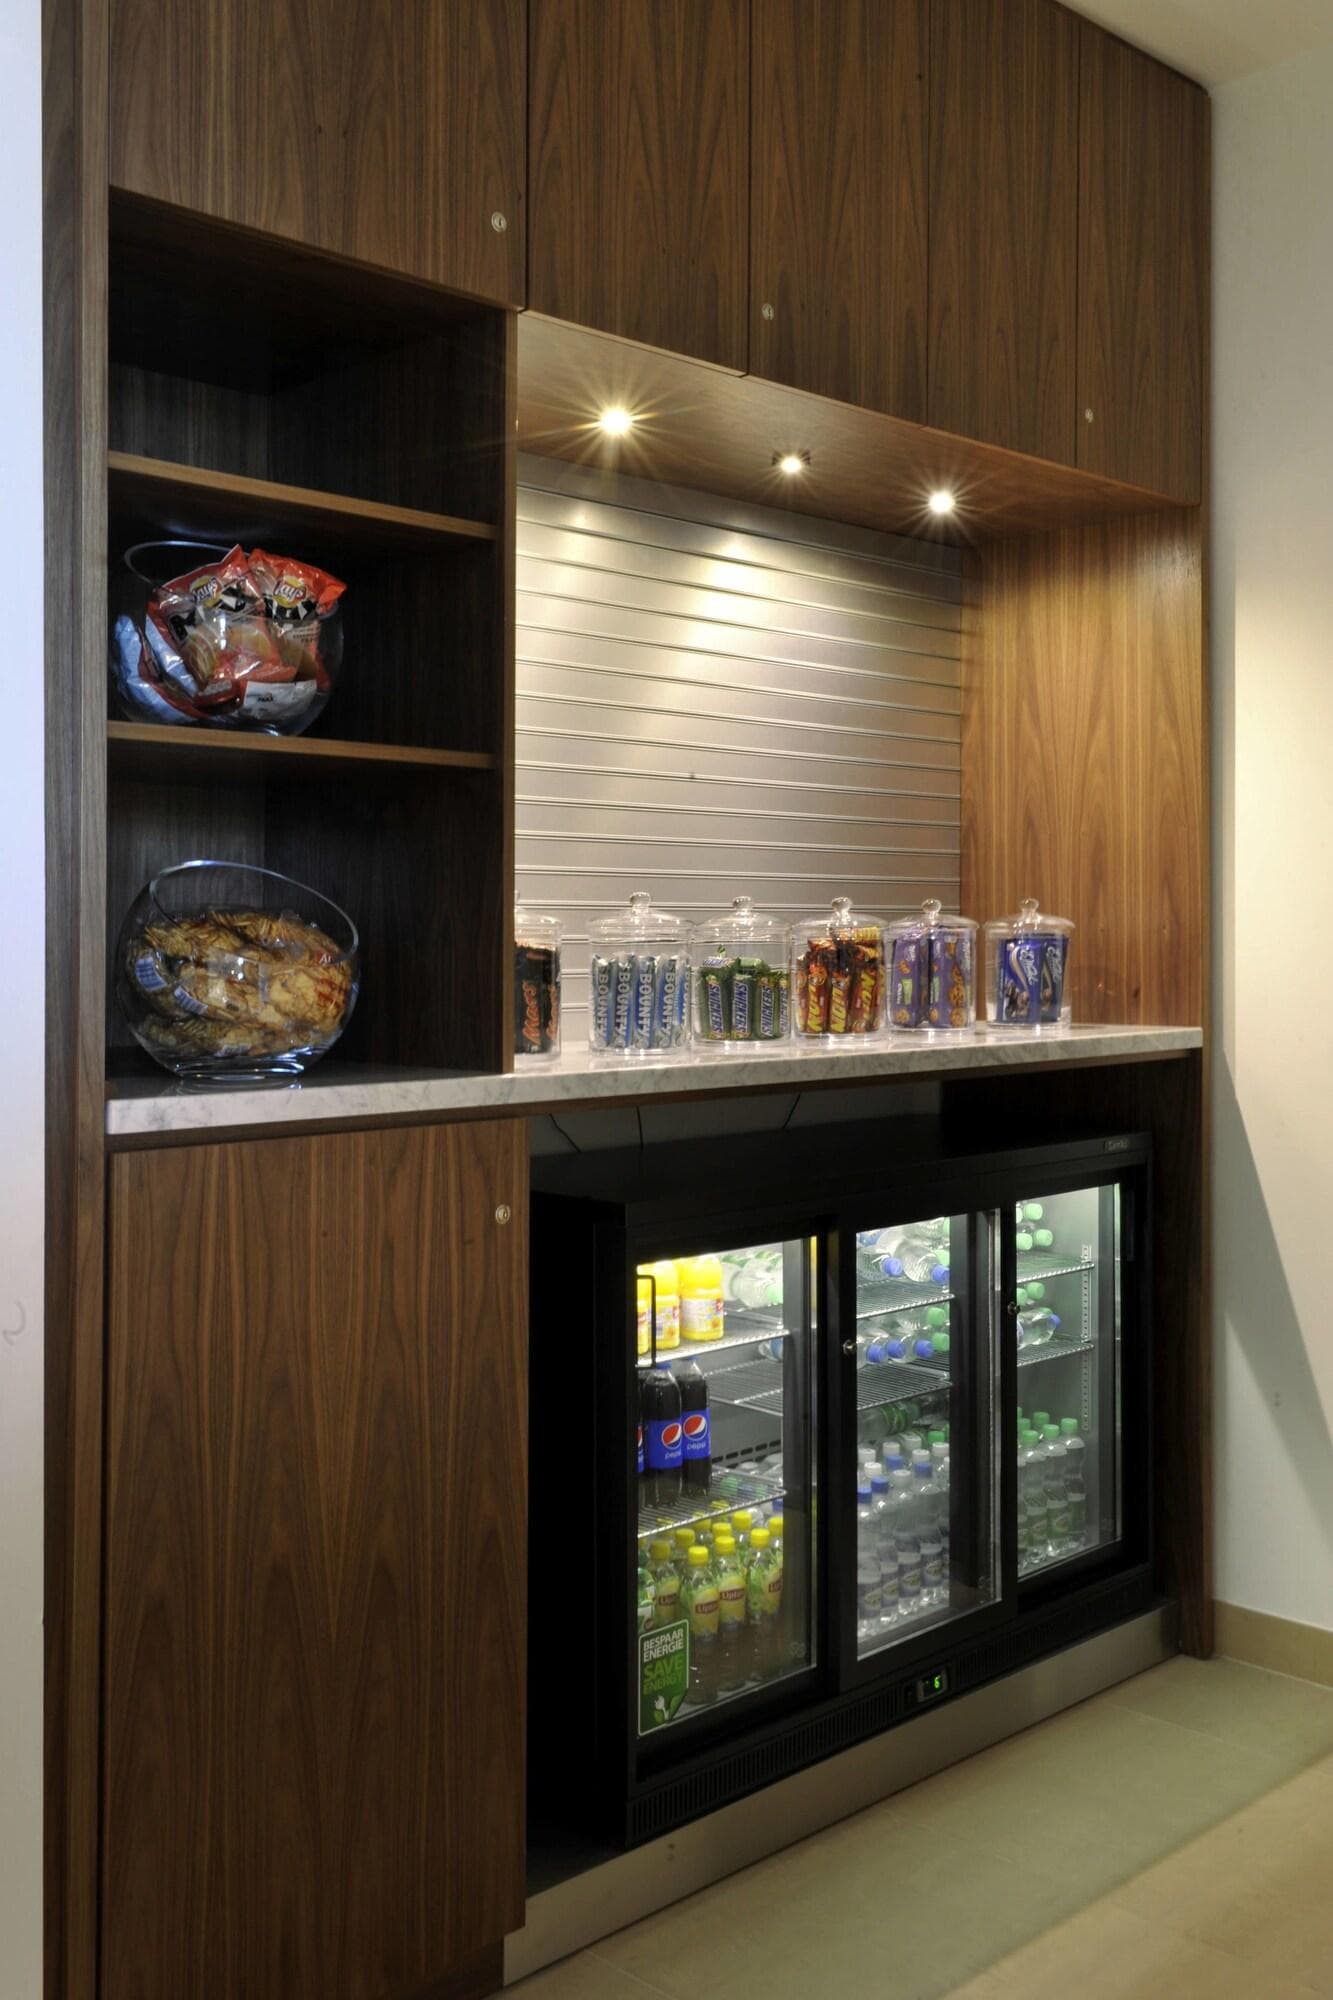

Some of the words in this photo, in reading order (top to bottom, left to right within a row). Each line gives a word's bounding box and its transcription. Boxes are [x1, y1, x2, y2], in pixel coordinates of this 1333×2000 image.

[613, 972, 630, 1036] BOUNTY
[638, 973, 652, 1037] BOUNTY
[662, 972, 675, 1035] BOUNTY
[709, 984, 723, 1033] SNICKERS
[734, 981, 748, 1033] SNICKERS
[761, 985, 774, 1036] SNICKERS
[830, 986, 847, 1032] LION
[644, 1628, 684, 1652] BESPAAR
[644, 1639, 684, 1663] ENERGIE
[644, 1653, 683, 1682] SAVE
[934, 1674, 941, 1689] 6
